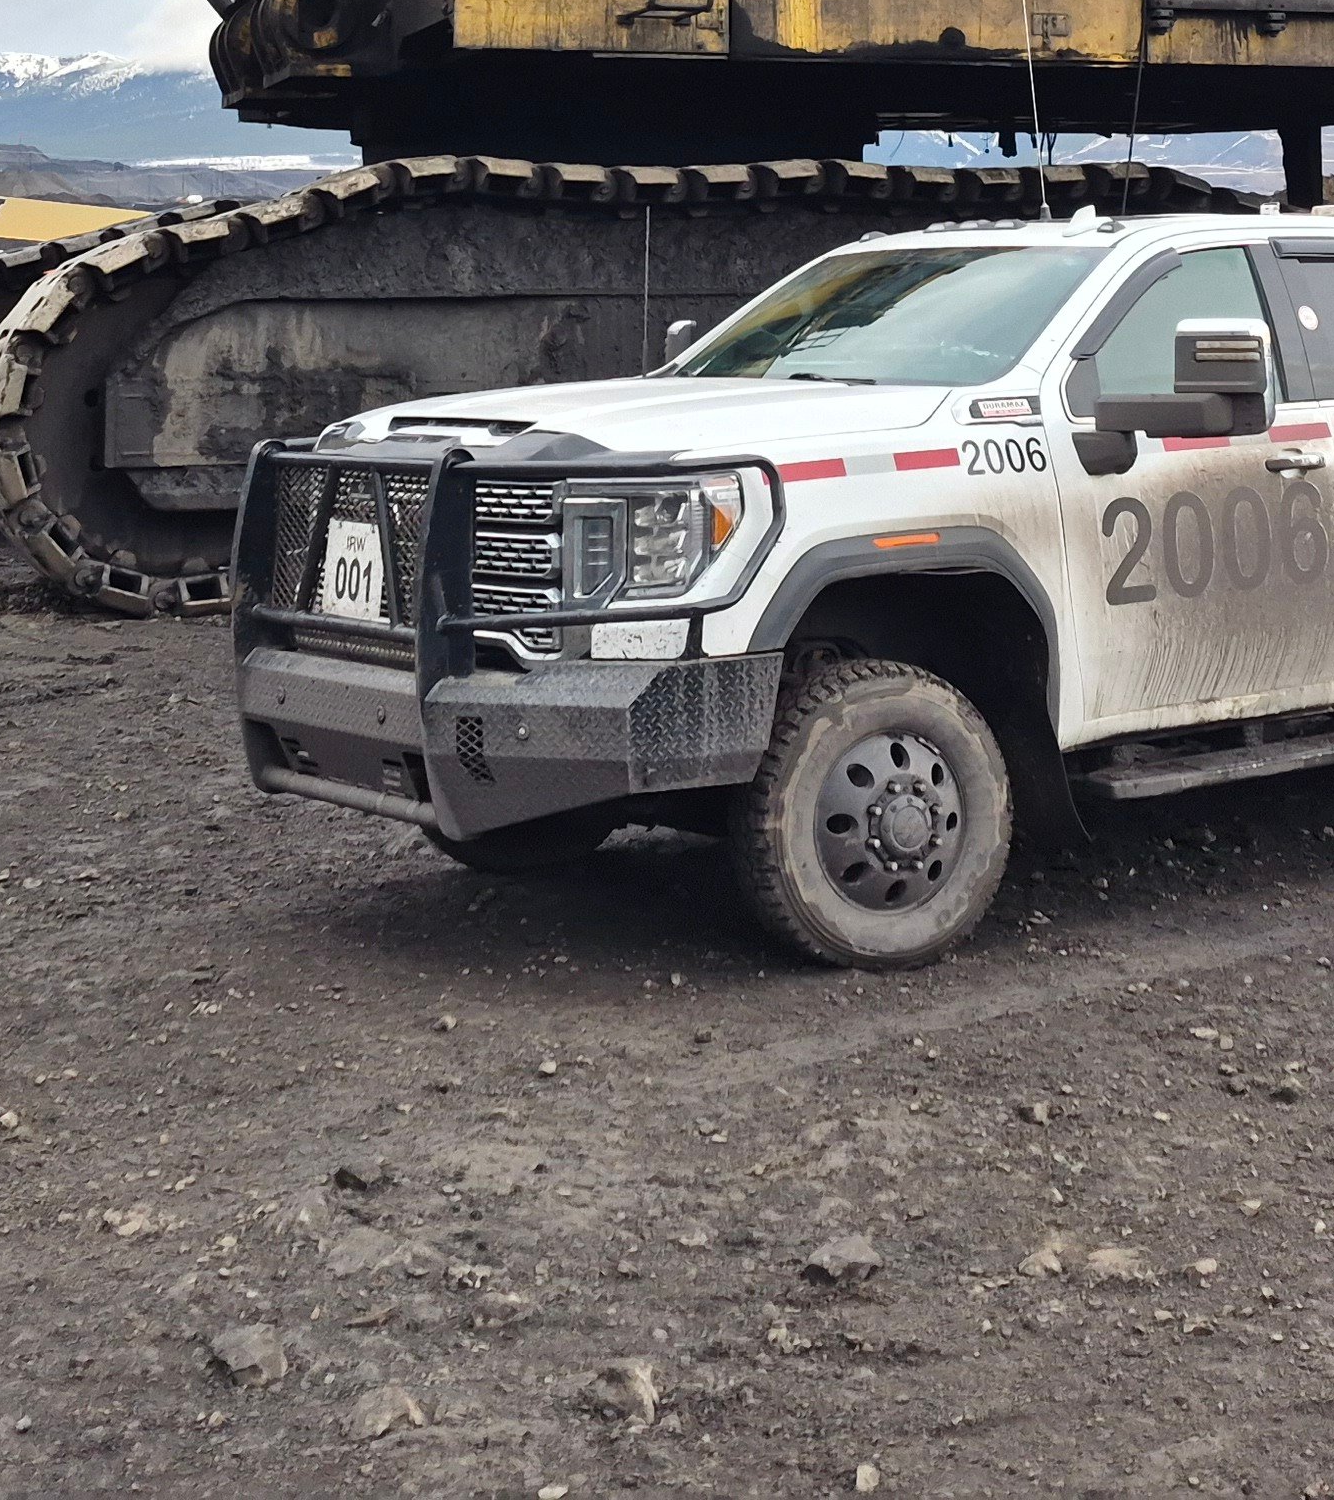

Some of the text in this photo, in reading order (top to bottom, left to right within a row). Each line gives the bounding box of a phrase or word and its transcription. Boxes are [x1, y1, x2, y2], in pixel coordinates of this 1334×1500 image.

[982, 401, 1025, 410] DURAMAX
[962, 437, 1047, 476] 2006
[1102, 480, 1330, 606] 2006
[335, 556, 373, 604] 001
